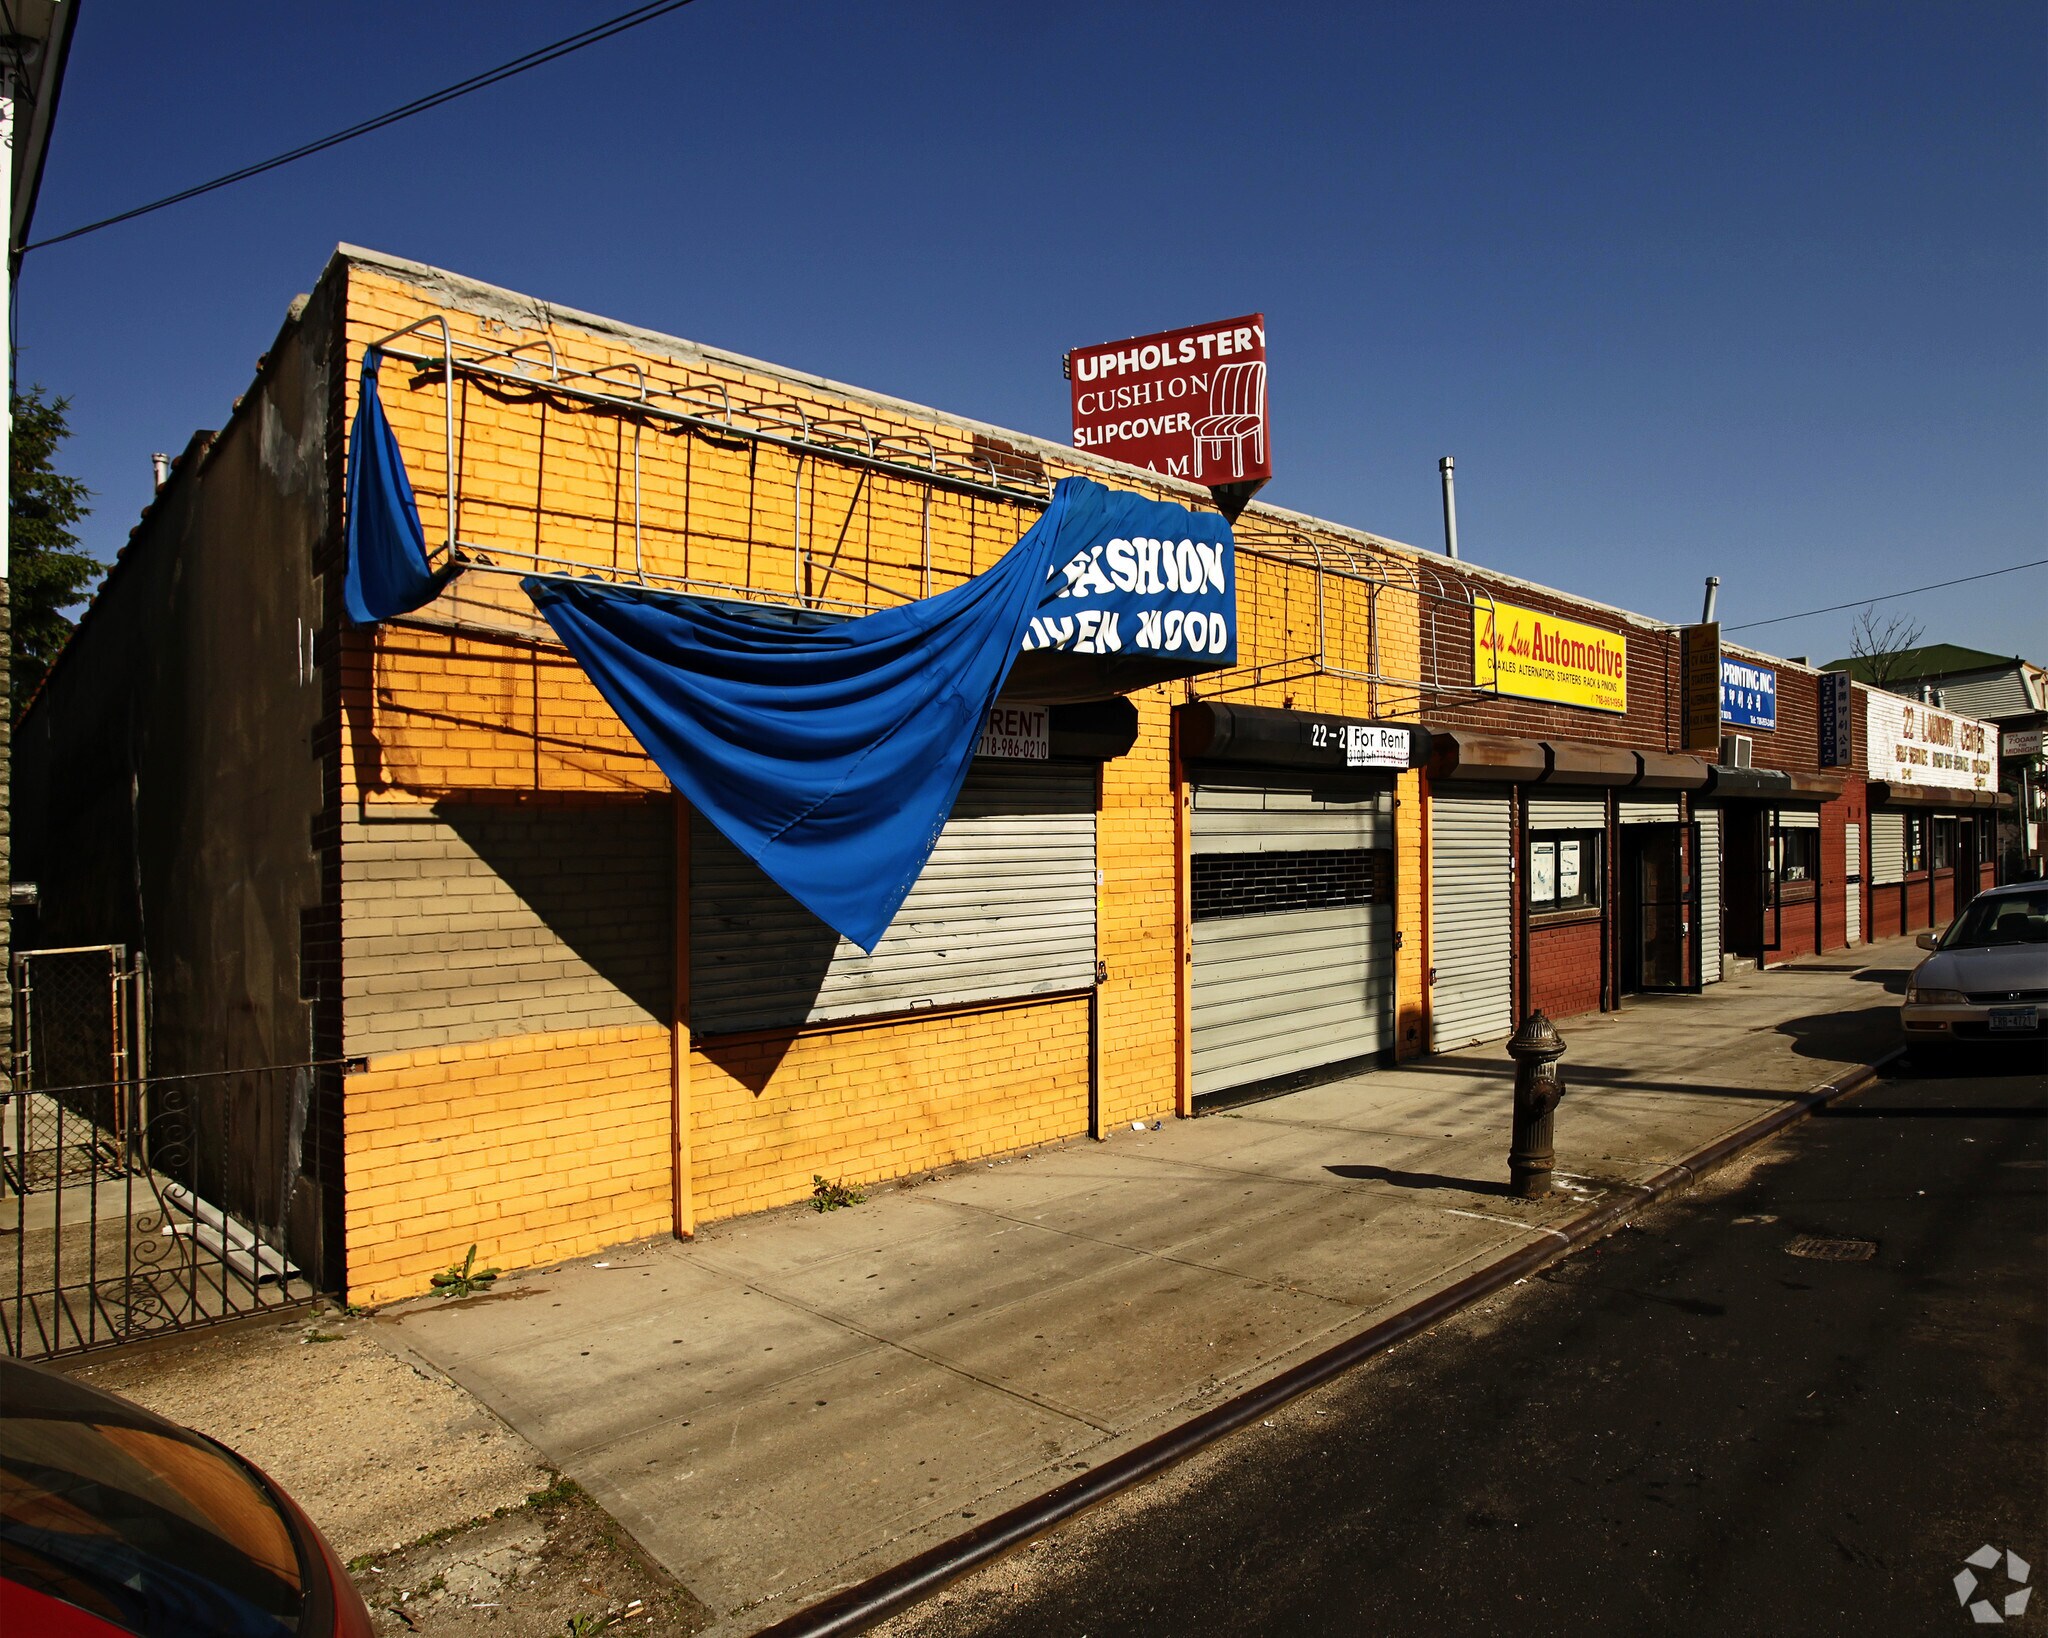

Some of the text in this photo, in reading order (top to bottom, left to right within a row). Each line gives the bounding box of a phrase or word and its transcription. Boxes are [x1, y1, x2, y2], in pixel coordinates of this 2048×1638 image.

[1077, 325, 1265, 382] UPHOLSTERY
[1077, 372, 1209, 415] CUSHION
[1073, 412, 1192, 448] SLIPCOVER
[1532, 621, 1623, 679] Automotive
[1519, 664, 1555, 681] ALTERNATORS
[1557, 671, 1582, 685] STARTERS
[1583, 676, 1596, 688] RACK
[1723, 662, 1760, 691] PRINTING
[989, 708, 1045, 738] RENT
[1903, 705, 1914, 739] 22
[1354, 728, 1405, 750] For Rent
[2005, 746, 2039, 755] MIDNIGHT
[2008, 736, 2037, 744] 7:00AM
